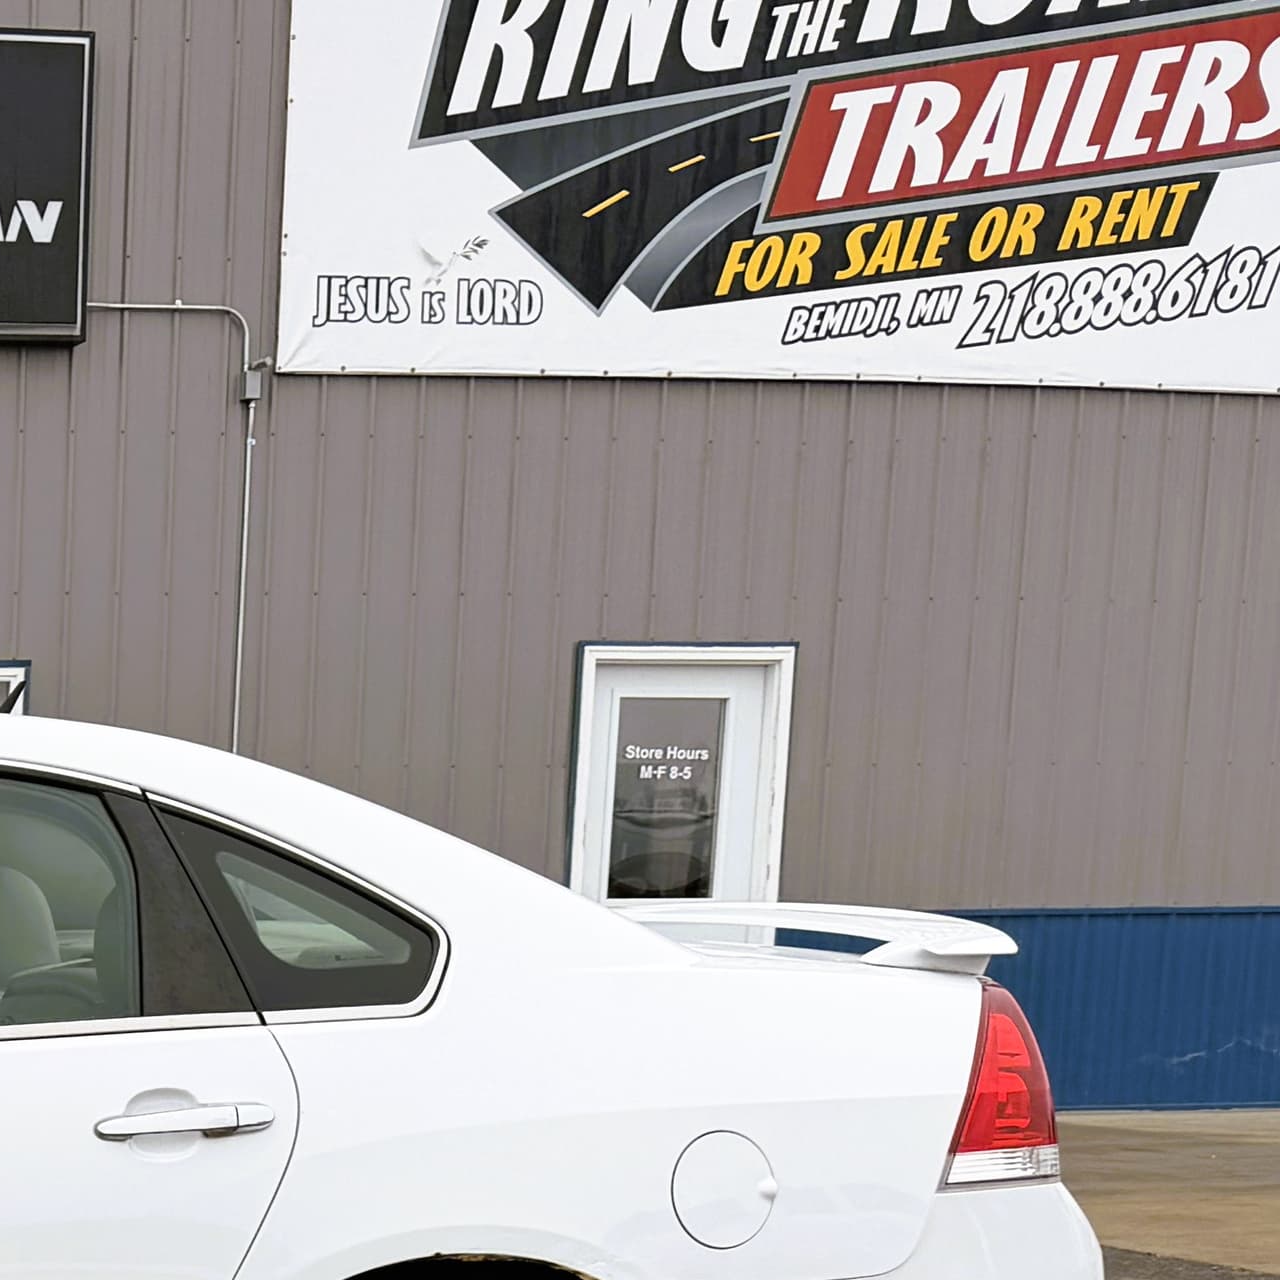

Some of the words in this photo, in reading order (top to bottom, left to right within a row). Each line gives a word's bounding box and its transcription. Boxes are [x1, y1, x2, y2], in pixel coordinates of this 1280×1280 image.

[764, 0, 845, 62] THE
[714, 231, 820, 296] FOR
[835, 212, 959, 279] SALE
[968, 203, 1045, 262] OR
[1056, 181, 1200, 251] RENT
[312, 275, 410, 327] JESUS
[456, 278, 543, 325] LORD
[781, 293, 901, 345] BEMIDJI,
[907, 285, 962, 328] MN
[954, 244, 1280, 349] 218.888.6181
[625, 745, 663, 759] Store
[666, 746, 709, 760] Hours
[640, 765, 667, 779] M-F
[669, 766, 692, 779] 8-5
